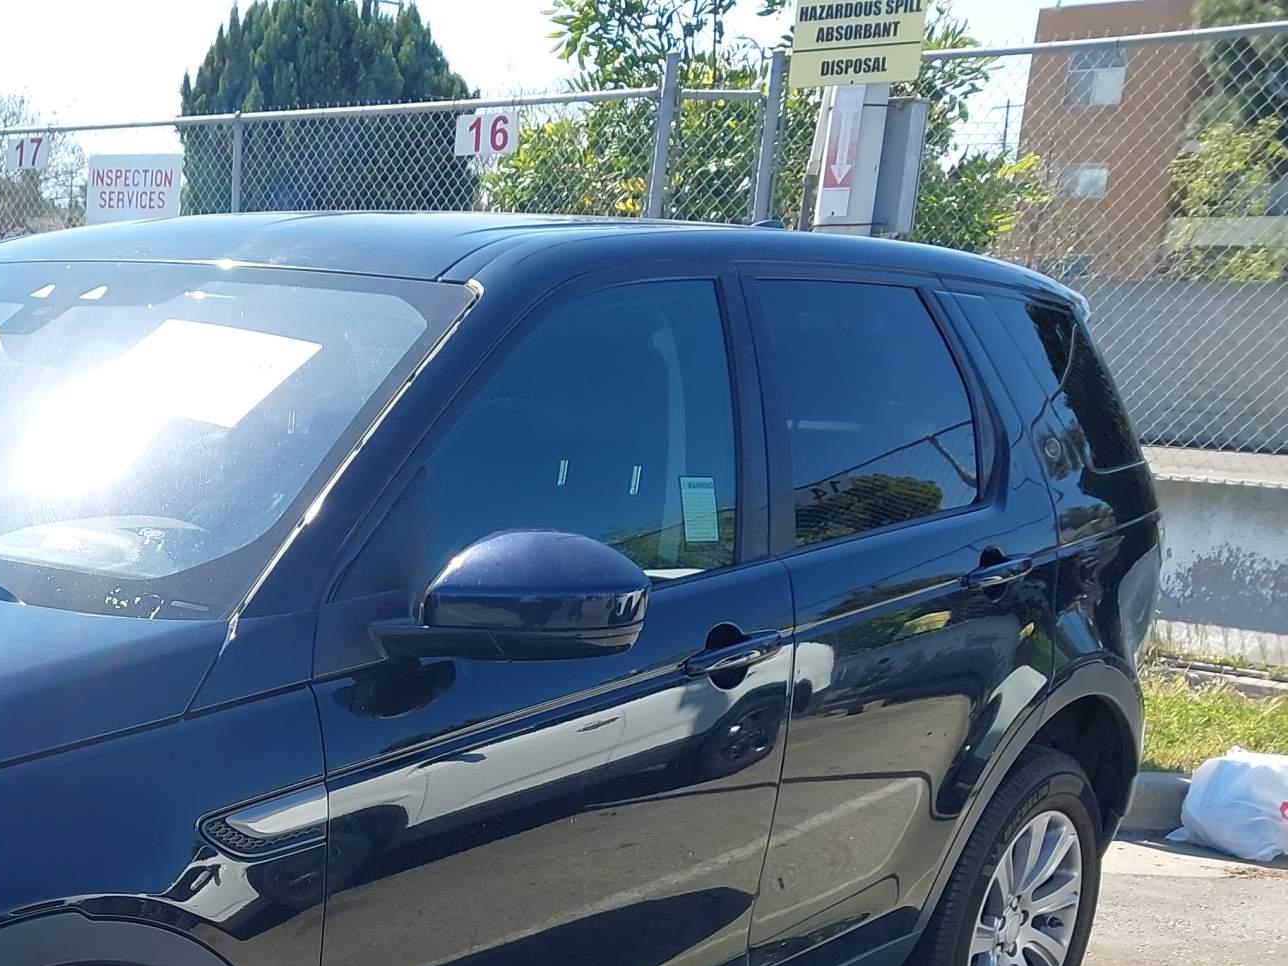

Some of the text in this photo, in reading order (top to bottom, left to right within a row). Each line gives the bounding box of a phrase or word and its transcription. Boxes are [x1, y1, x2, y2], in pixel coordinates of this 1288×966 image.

[799, 0, 923, 22] HAZARDOUS SPILL
[816, 21, 901, 43] ABSORBANT
[820, 56, 887, 77] DISPOSAL
[469, 115, 509, 152] 16
[15, 137, 42, 167] 17
[91, 168, 173, 187] INSPECTION
[99, 191, 165, 209] SERVICES
